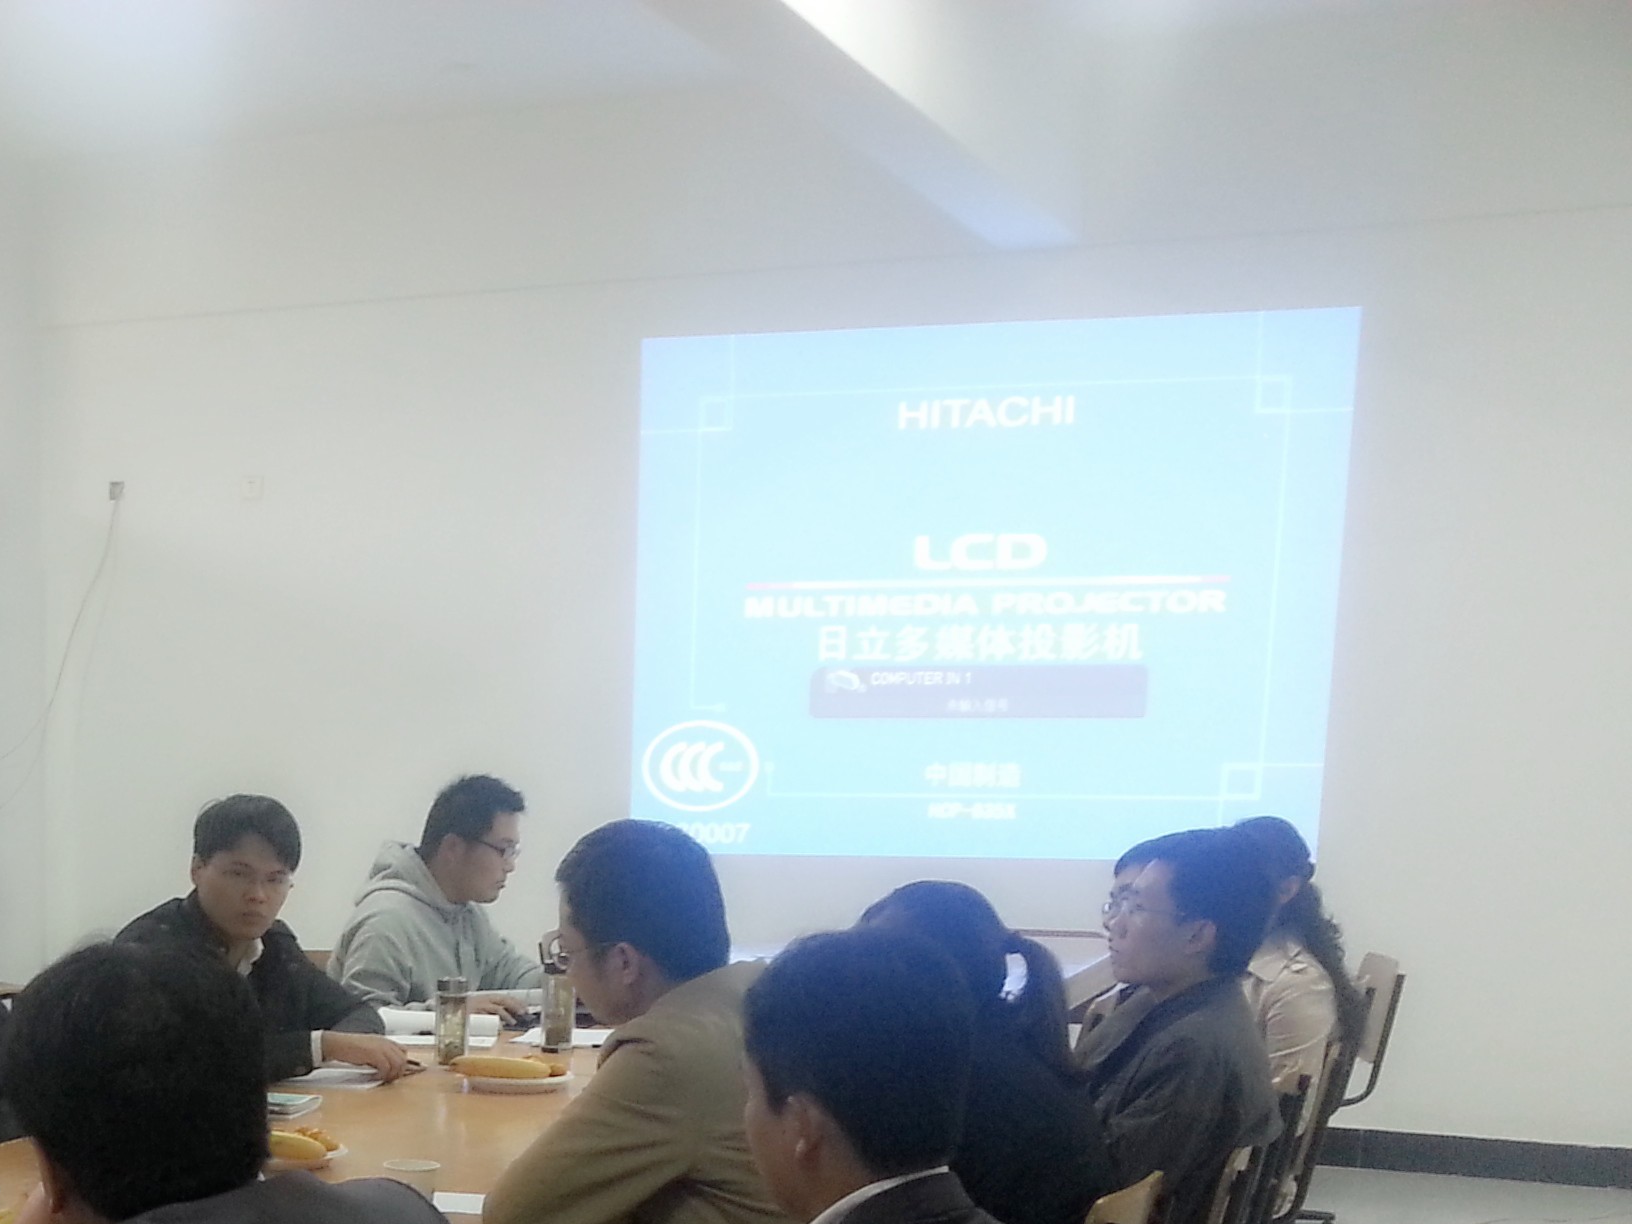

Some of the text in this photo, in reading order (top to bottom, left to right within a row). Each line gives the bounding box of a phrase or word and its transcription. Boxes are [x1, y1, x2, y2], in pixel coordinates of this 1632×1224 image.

[897, 396, 1075, 431] HITACHI
[912, 533, 1048, 572] LCD
[744, 588, 1227, 619] MULTIMEDIA PROJECTOR
[817, 622, 1143, 662] 日立多媒体投影机
[870, 671, 943, 687] COMPUTER
[924, 762, 1022, 787] 中国制造
